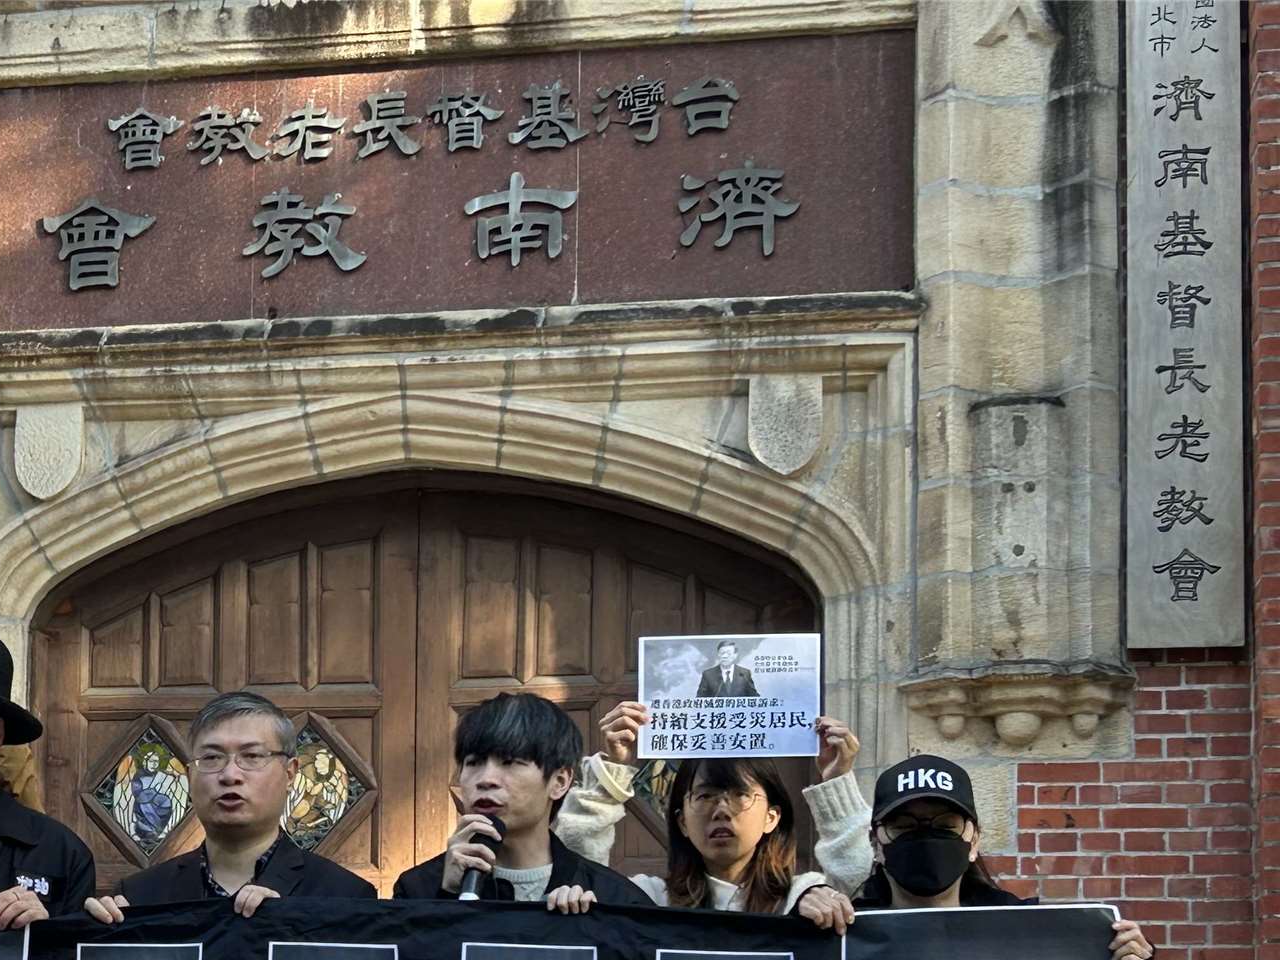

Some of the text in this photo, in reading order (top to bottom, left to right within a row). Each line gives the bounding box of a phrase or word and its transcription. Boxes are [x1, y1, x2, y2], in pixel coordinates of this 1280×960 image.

[107, 75, 740, 172] 台灣基督長老教會
[42, 159, 800, 292] 濟南教會
[1152, 75, 1222, 602] 濟南基督長老教會
[897, 768, 954, 793] HKG
